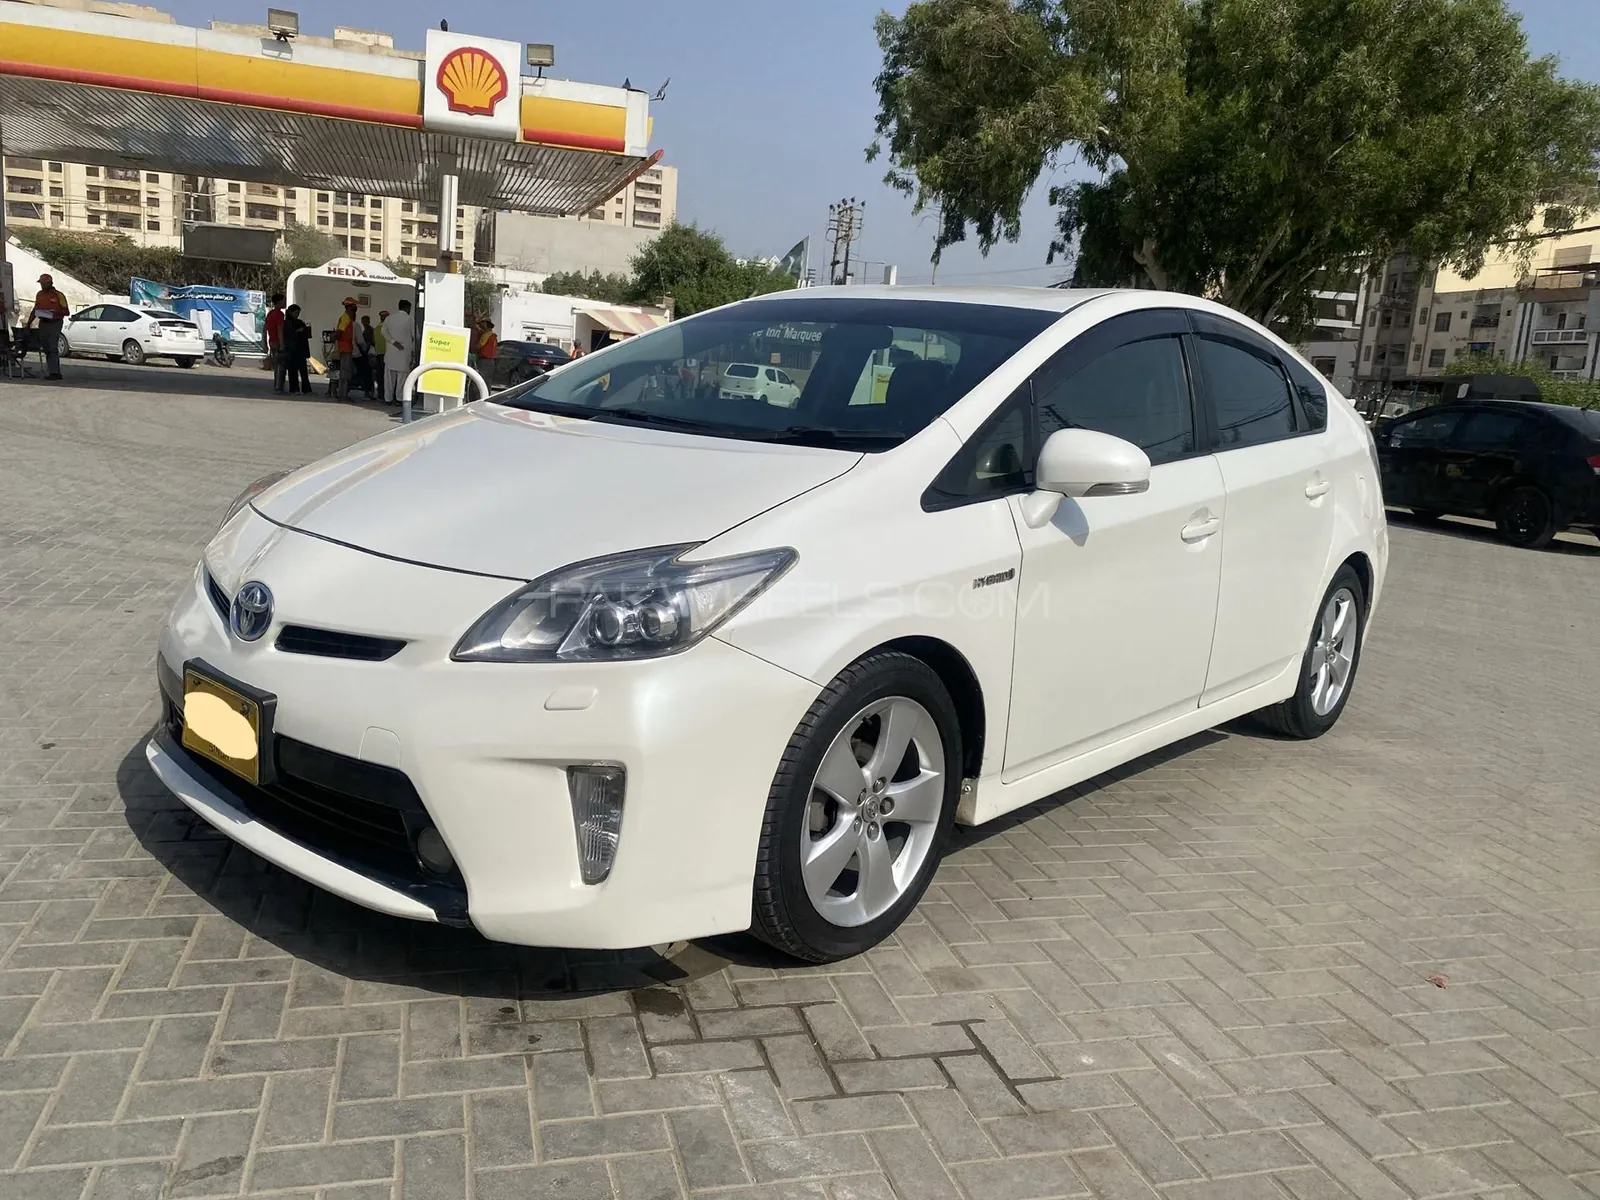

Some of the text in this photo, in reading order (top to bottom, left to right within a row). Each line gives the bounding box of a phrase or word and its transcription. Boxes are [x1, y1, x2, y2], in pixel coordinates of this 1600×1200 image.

[327, 266, 367, 278] HELIX
[784, 327, 822, 342] Marquee
[429, 337, 450, 346] Super
[973, 568, 1015, 590] HYBRID
